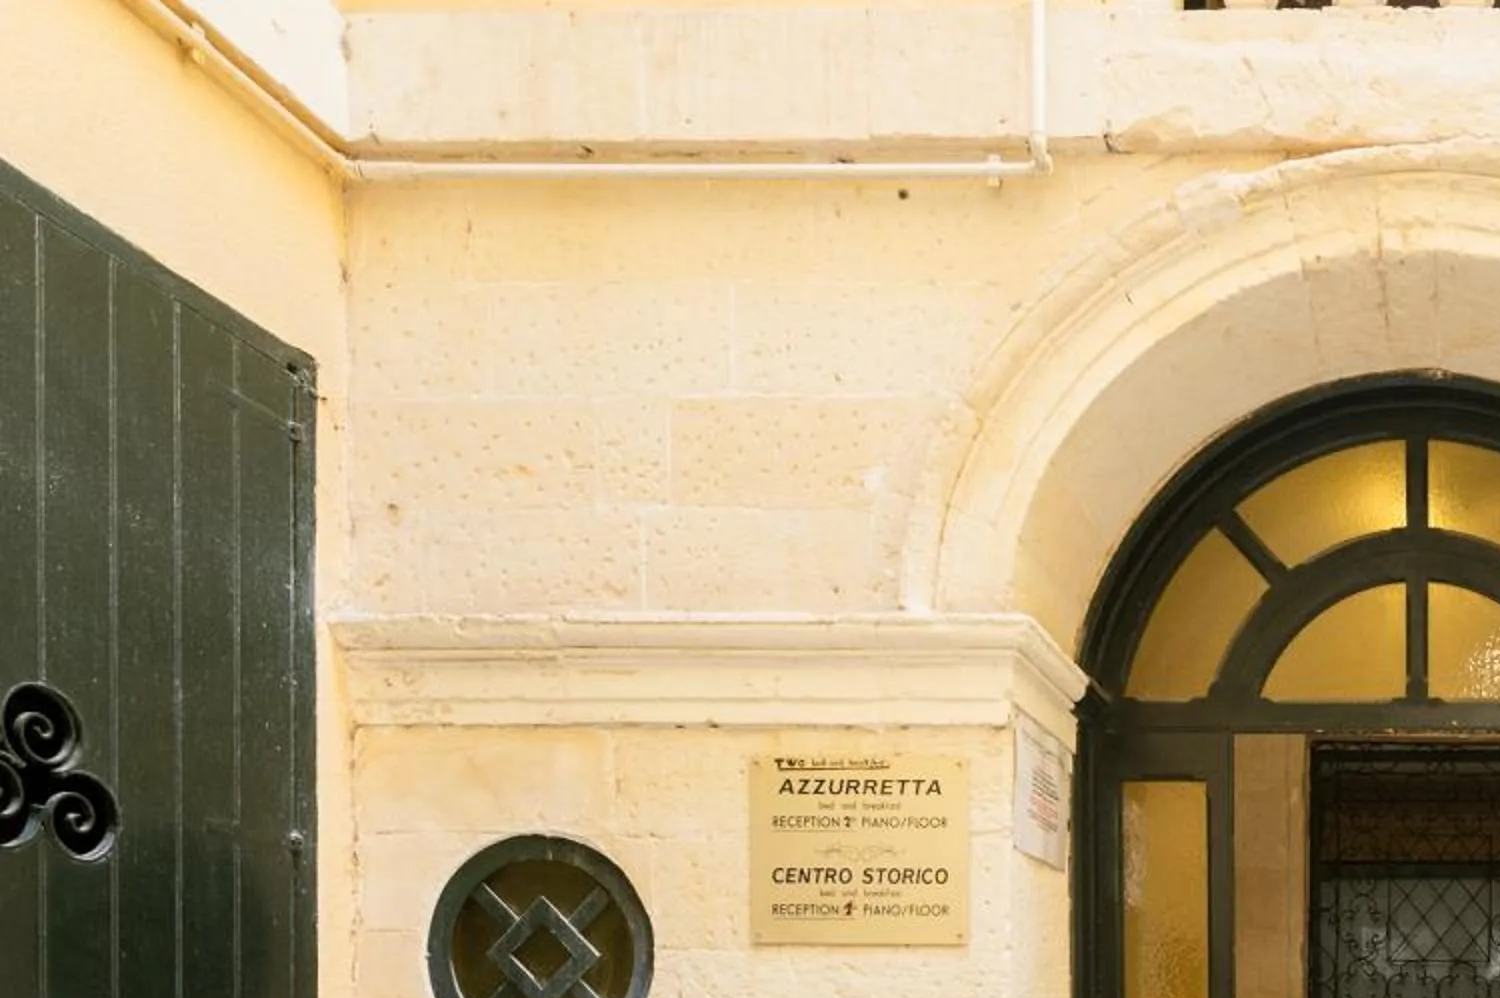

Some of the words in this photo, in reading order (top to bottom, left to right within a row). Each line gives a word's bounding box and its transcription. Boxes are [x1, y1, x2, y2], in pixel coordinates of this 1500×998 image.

[779, 779, 942, 795] AZZURRETTA
[772, 815, 840, 828] RECEPTION
[861, 815, 948, 829] PIANO/FLOOR
[771, 868, 853, 884] CENTRO
[862, 868, 949, 884] STORICO
[771, 903, 840, 916] RECEPTION
[862, 903, 950, 917] PIANO/FLOOR
